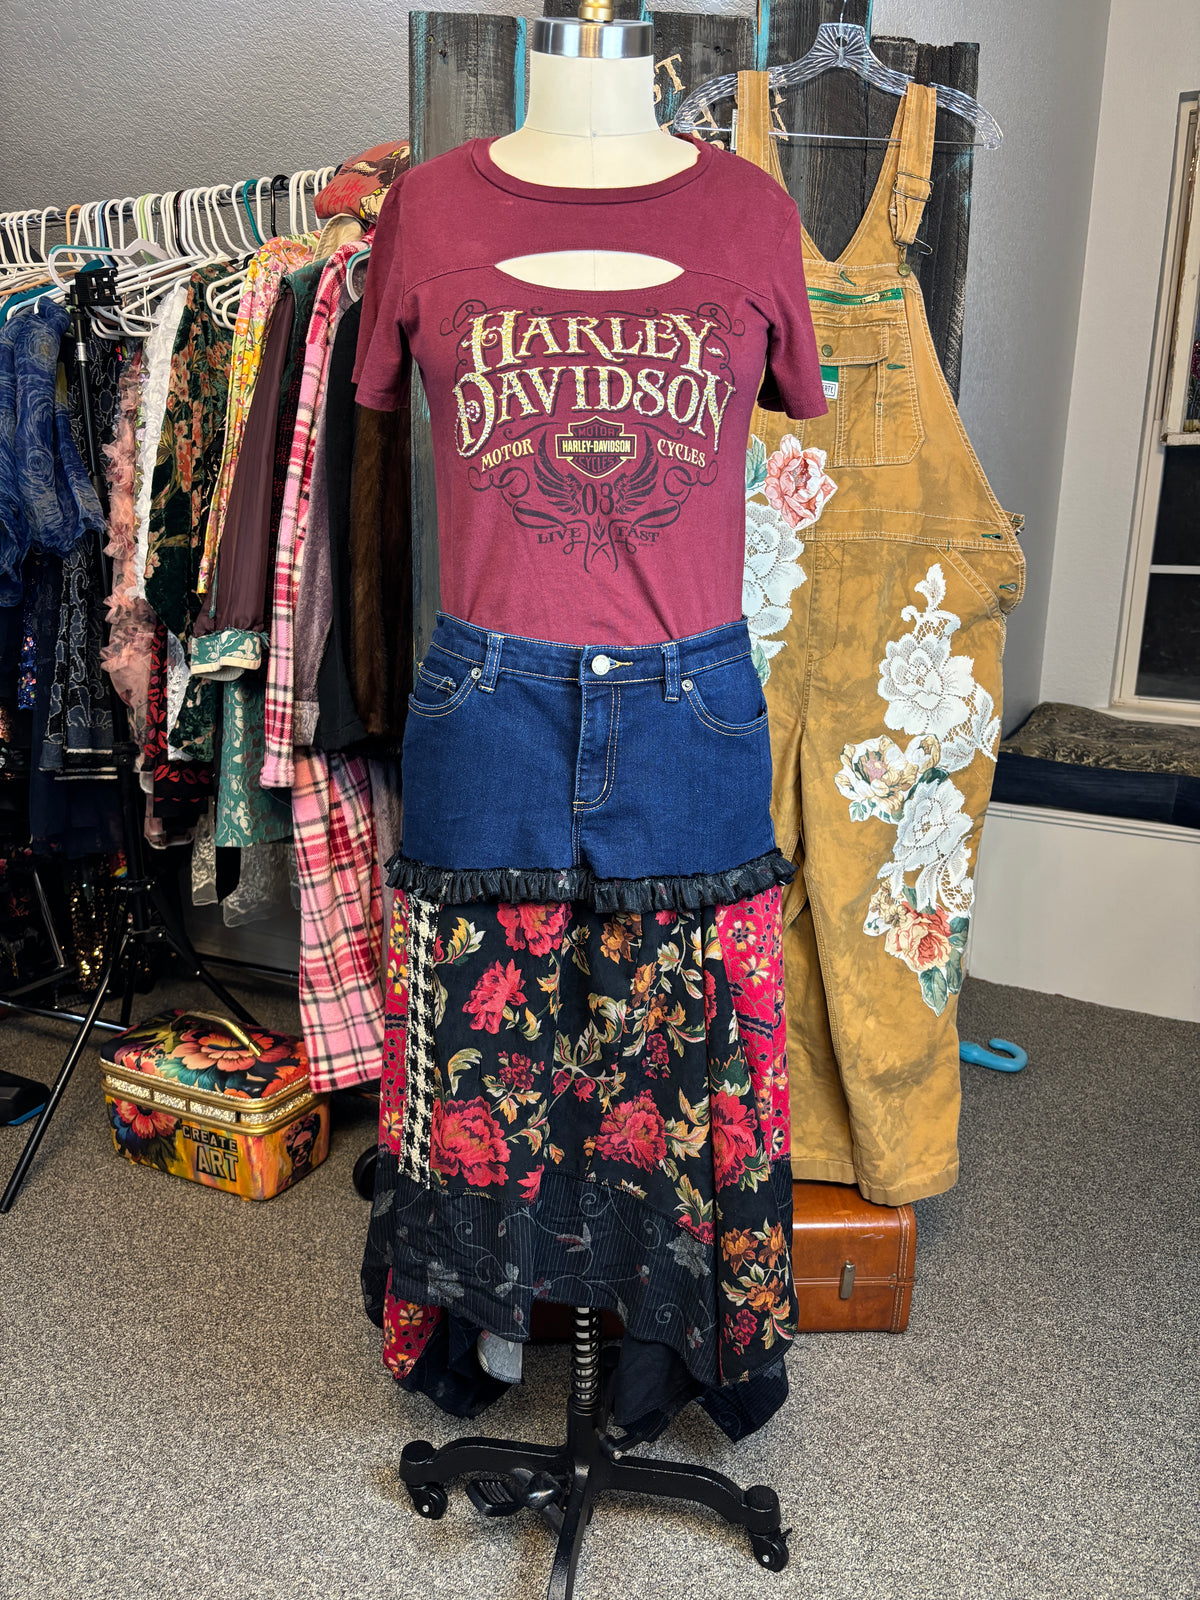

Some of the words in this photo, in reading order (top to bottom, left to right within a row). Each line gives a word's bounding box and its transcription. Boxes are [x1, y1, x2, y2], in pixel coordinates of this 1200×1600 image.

[452, 366, 737, 458] DAVIDSON
[578, 424, 615, 437] MOTOR
[481, 439, 535, 473] MOTOR
[657, 439, 706, 468] CYCLES
[562, 440, 631, 453] HARLEY-DAVIDSON
[578, 456, 615, 472] CYCLES
[582, 483, 615, 516] 03
[537, 527, 582, 544] LIVE
[617, 527, 660, 543] FAST
[182, 1125, 238, 1152] CREATE
[197, 1145, 239, 1182] ART
